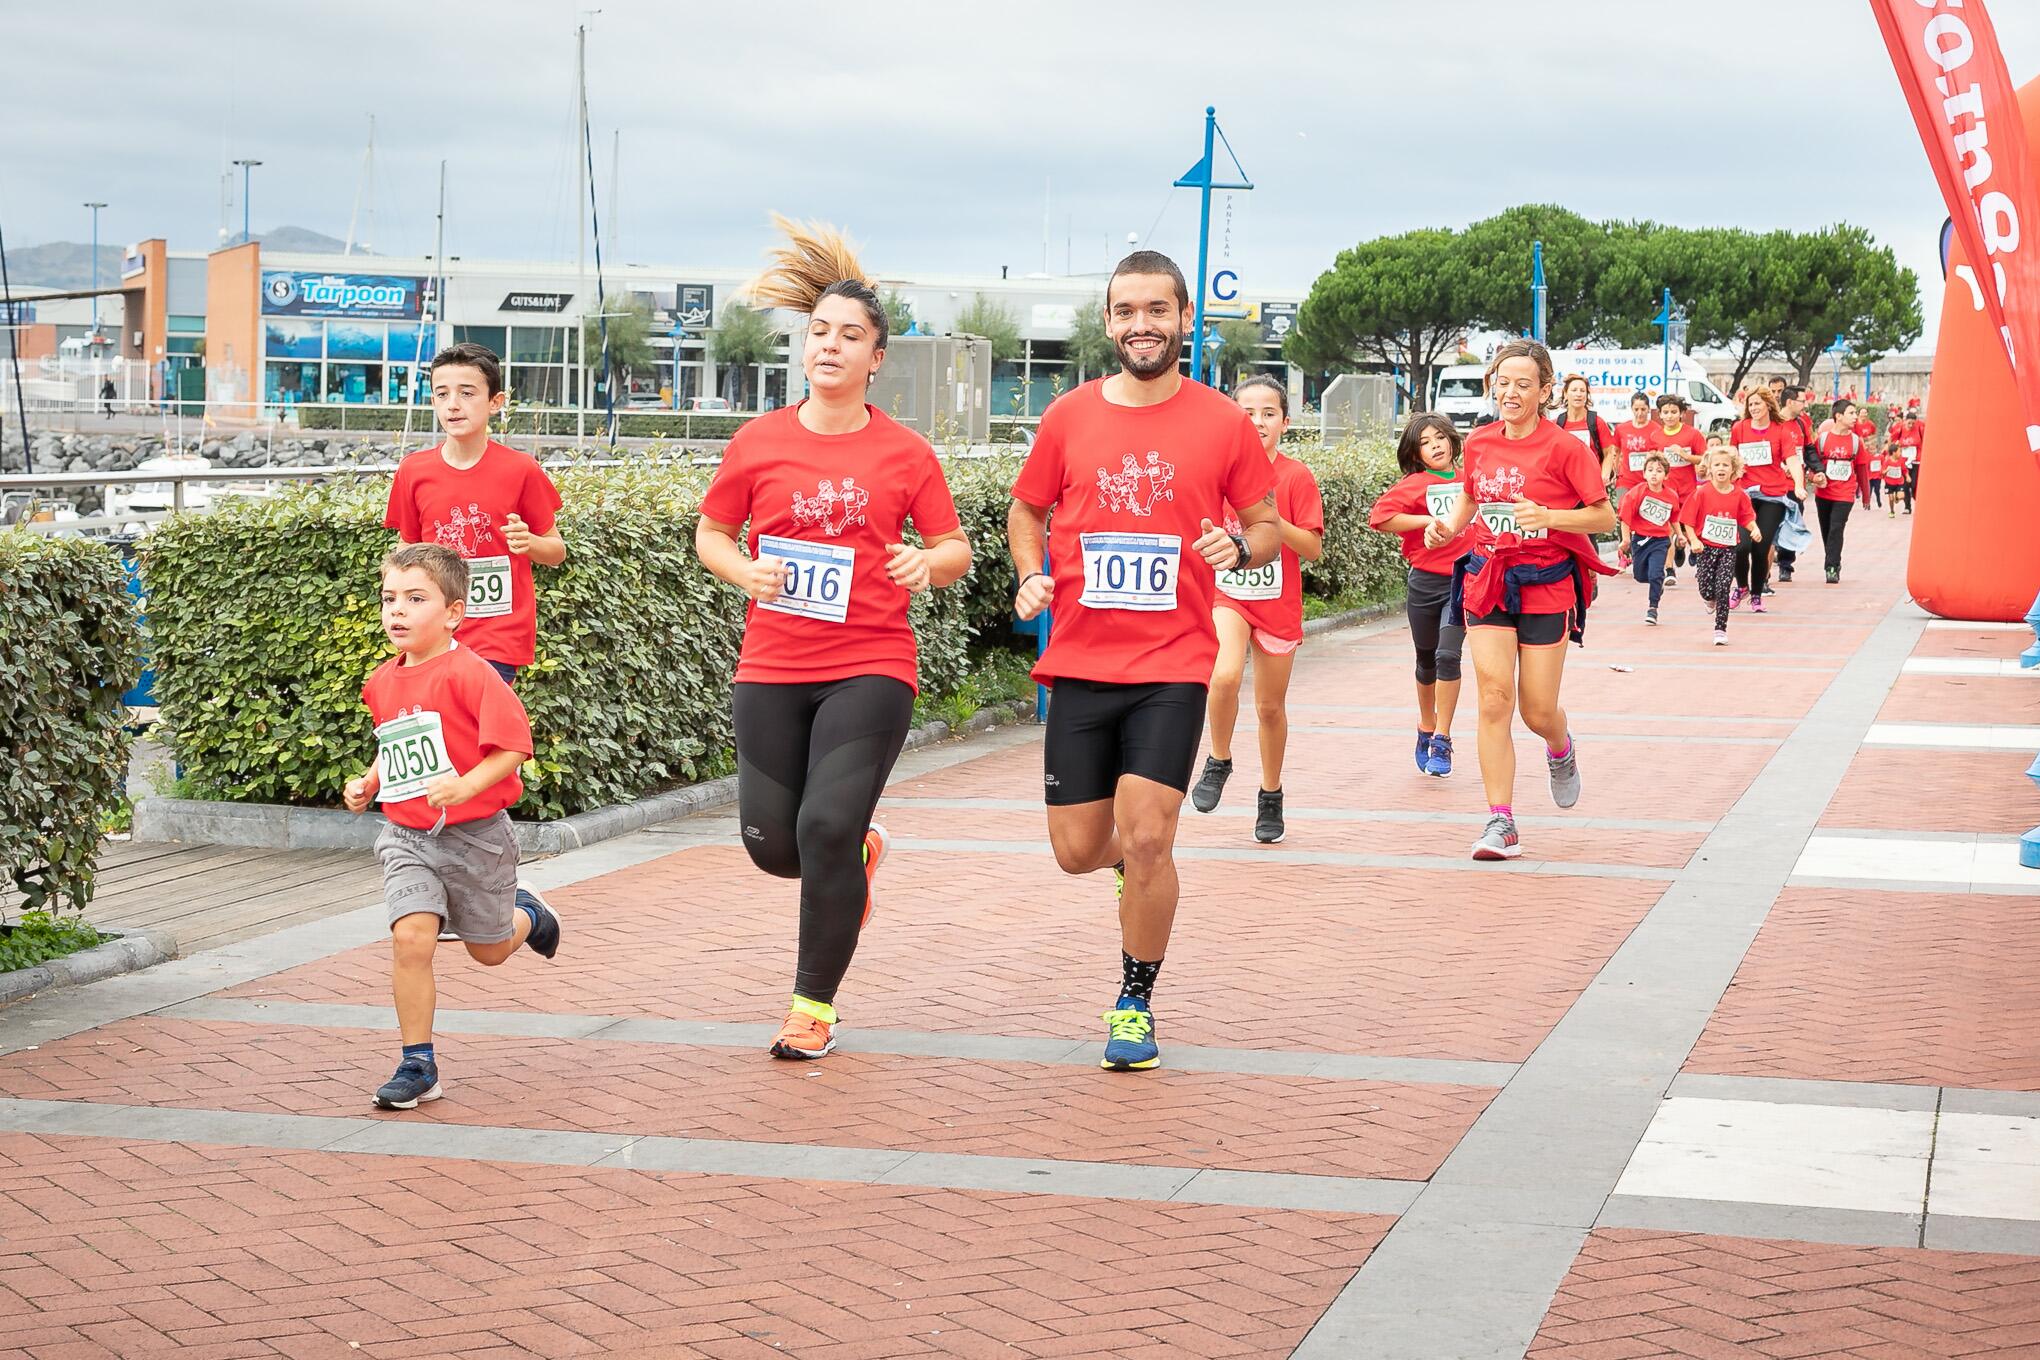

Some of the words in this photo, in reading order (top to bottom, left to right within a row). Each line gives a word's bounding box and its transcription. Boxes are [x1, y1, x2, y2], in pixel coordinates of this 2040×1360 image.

[1224, 195, 1233, 258] PANTALAN
[302, 279, 405, 307] Tarpoon
[1212, 270, 1239, 301] C
[510, 296, 561, 307] GUTS&LOVE
[1671, 360, 1682, 373] A
[1643, 502, 1668, 521] 2050
[1707, 523, 1734, 539] 2050
[783, 561, 840, 602] 016
[1094, 554, 1168, 592] 1016
[470, 574, 503, 604] 59
[382, 735, 439, 782] 2050
